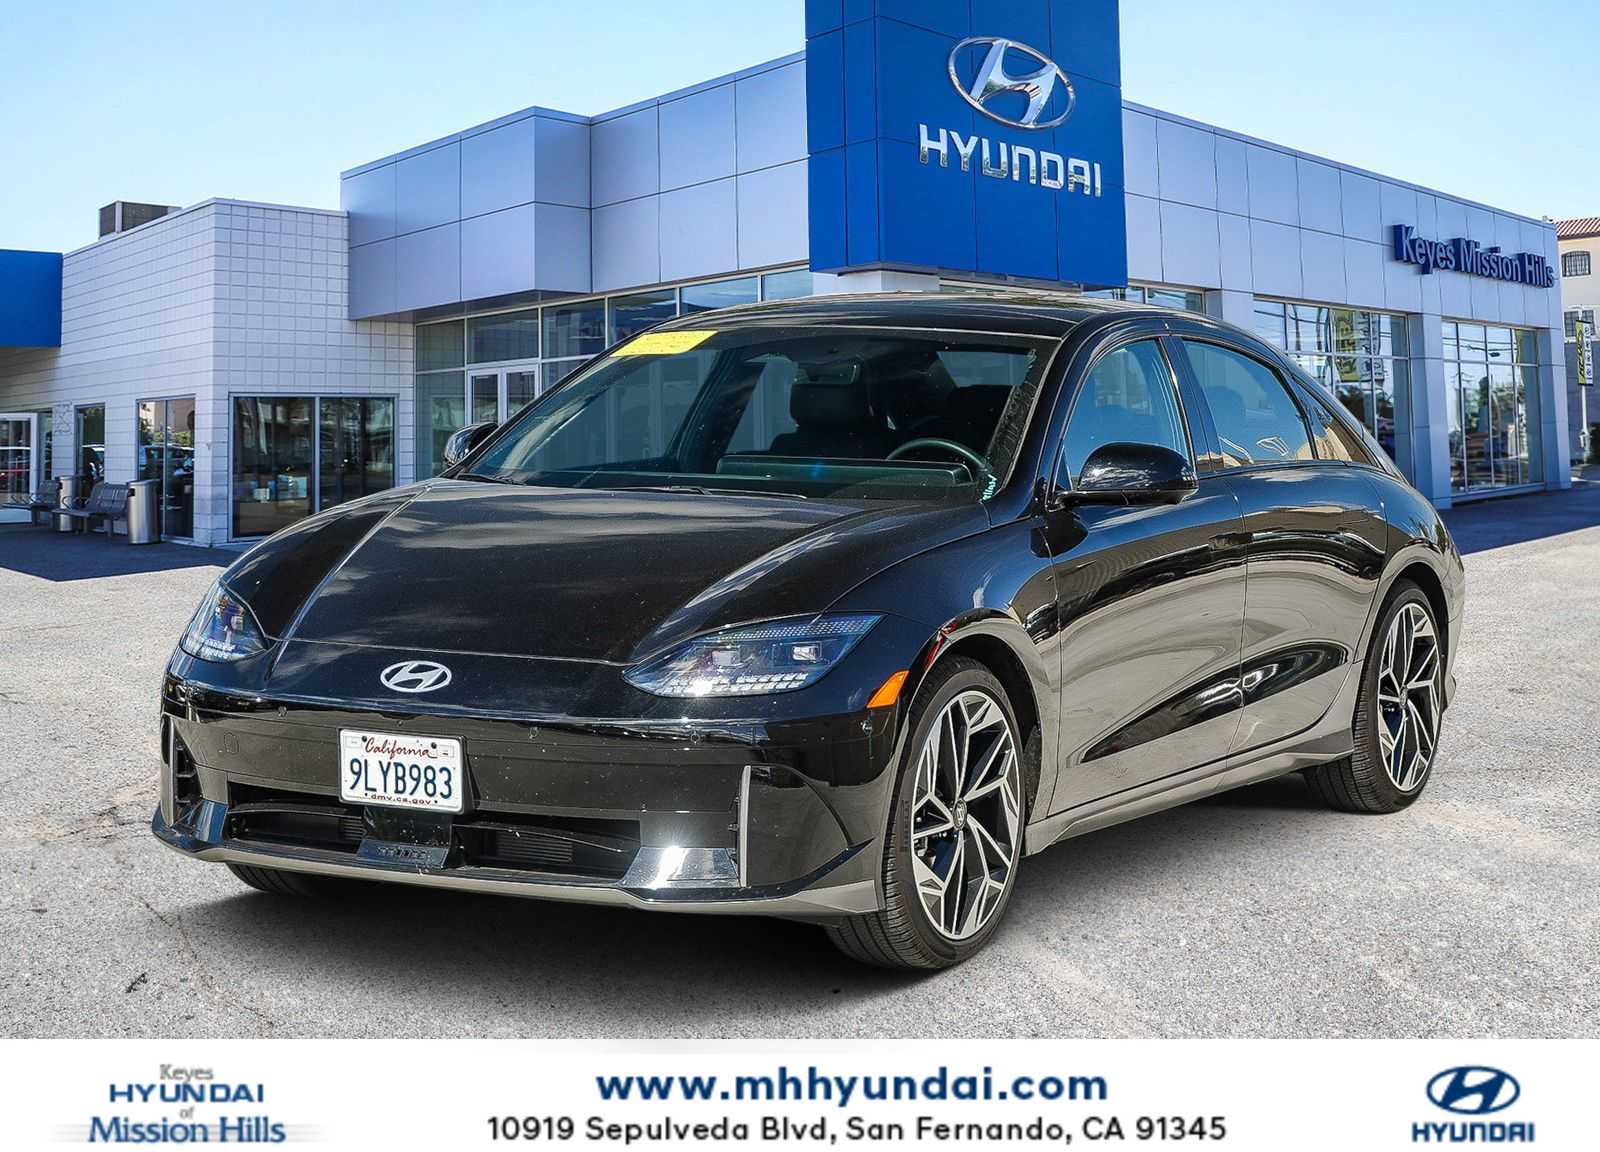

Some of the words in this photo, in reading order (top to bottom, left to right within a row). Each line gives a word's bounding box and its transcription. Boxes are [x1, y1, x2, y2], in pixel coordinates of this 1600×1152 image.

[919, 124, 1102, 198] HYUNDAI
[1397, 224, 1455, 272] Keyes
[1457, 238, 1522, 282] Mission
[1523, 252, 1554, 288] Hills
[364, 737, 436, 759] California
[349, 758, 453, 800] 9LYB983
[371, 794, 432, 805] dmv.ca.gov
